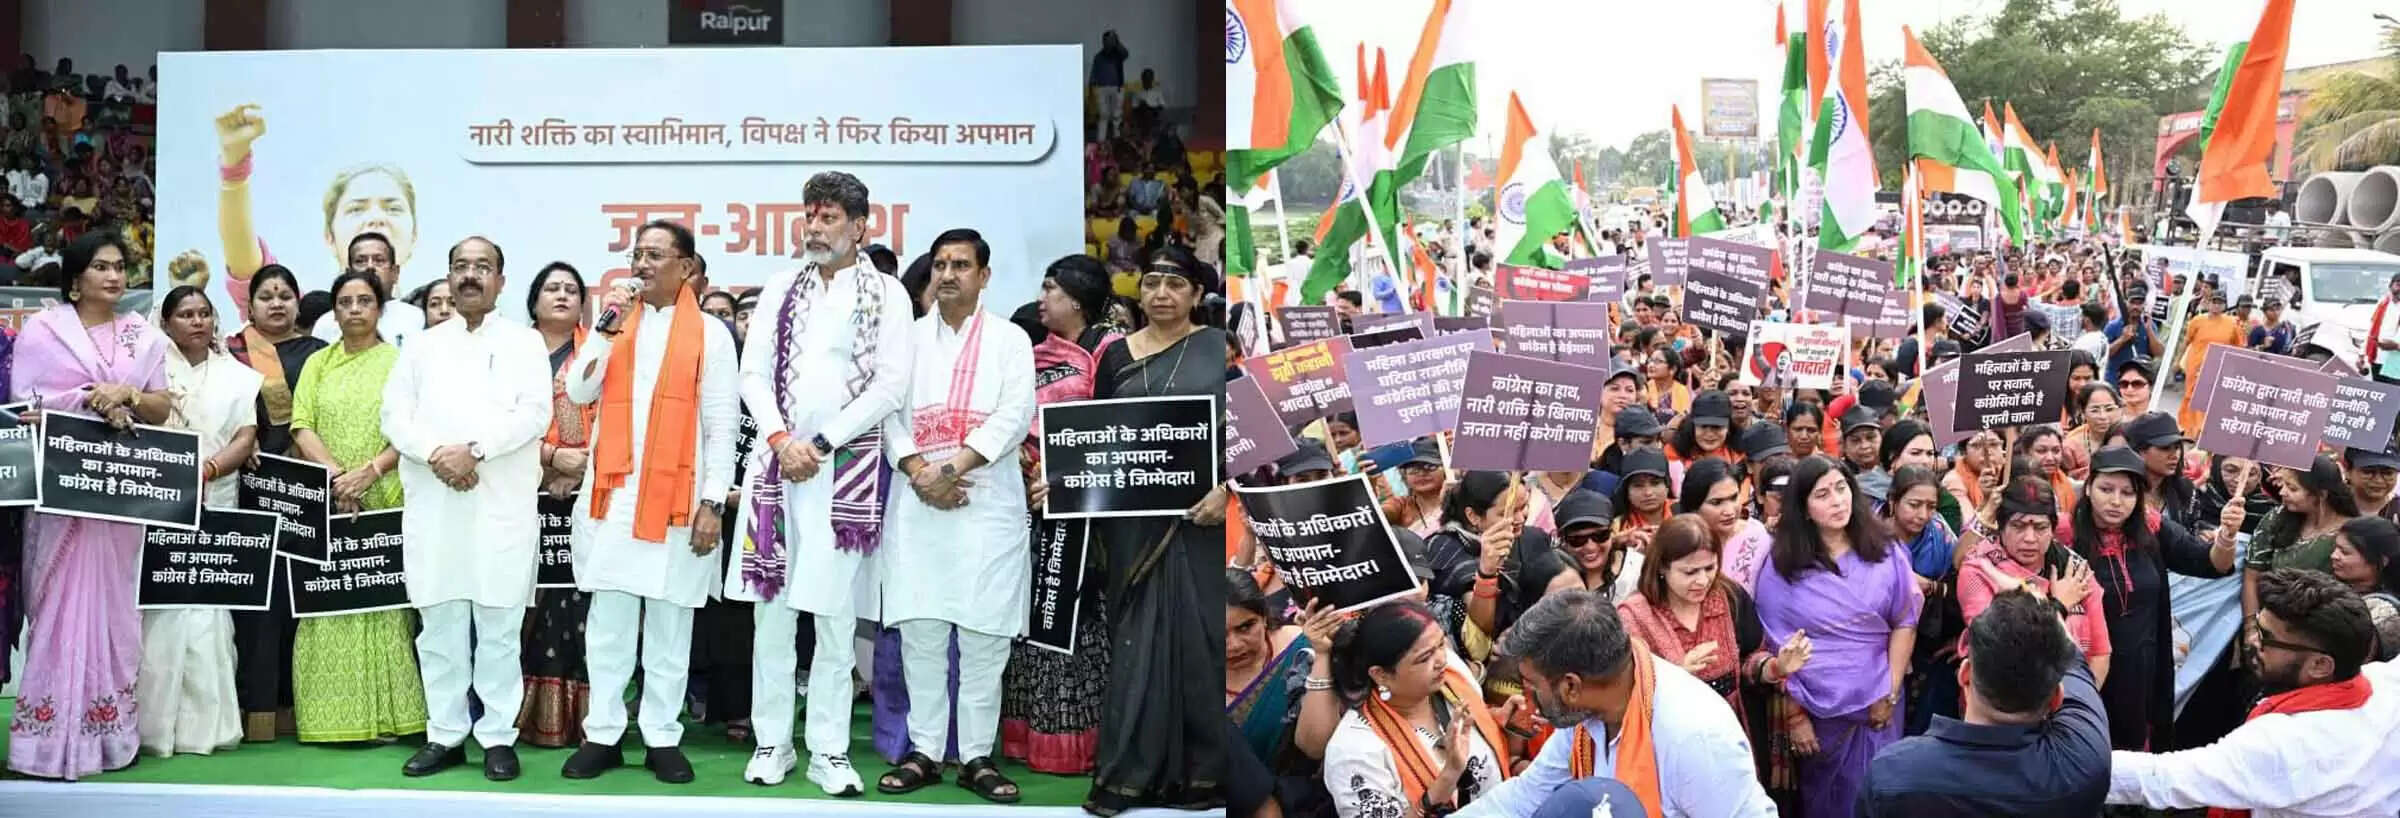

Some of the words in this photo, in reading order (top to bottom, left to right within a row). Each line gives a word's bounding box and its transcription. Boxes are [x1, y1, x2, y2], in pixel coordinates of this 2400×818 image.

[701, 11, 772, 35] Raipur
[469, 119, 513, 146] नारी
[521, 118, 577, 147] शक्ति
[583, 124, 615, 146] का
[621, 117, 733, 148] स्वाभिमान,
[741, 117, 808, 145] विपक्ष
[813, 117, 830, 145] ने
[837, 117, 882, 145] फिर
[889, 117, 948, 145] किया
[956, 123, 1035, 145] अपमान
[1509, 324, 1551, 338] महिलाओं
[1552, 328, 1567, 338] का
[1568, 329, 1603, 339] अपमान
[1518, 340, 1548, 353] कांग्रेस
[1548, 340, 1557, 354] है
[1364, 355, 1406, 371] महिला
[1408, 345, 1456, 363] आरक्षण
[1975, 359, 2020, 375] महिलाओं
[2021, 359, 2032, 373] के
[2033, 360, 2051, 373] हक
[1377, 371, 1417, 387] घटिया
[1492, 374, 1534, 395] कांग्रेस
[1535, 382, 1553, 398] का
[1554, 385, 1581, 402] हाथ,
[1988, 379, 2002, 391] पर
[2003, 378, 2034, 391] सवाल,
[1279, 394, 1314, 413] आदत
[1313, 381, 1352, 409] पुरानी
[1372, 384, 1431, 406] कांग्रेसियों
[1433, 379, 1450, 393] की
[1974, 392, 2021, 409] कांग्रेसियों
[2021, 392, 2035, 406] की
[2036, 390, 2045, 407] है
[2221, 374, 2257, 394] कांग्रेस
[2256, 382, 2280, 402] द्वारा
[2280, 385, 2303, 404] नारी
[2303, 391, 2329, 410] शक्ति
[2369, 390, 2386, 403] पर
[1398, 402, 1433, 424] पुरानी
[1466, 394, 1495, 414] नारी
[1497, 398, 1530, 418] शक्ति
[1531, 400, 1546, 418] के
[1547, 401, 1594, 425] खिलाफ,
[1981, 411, 2009, 429] पुरानी
[2011, 411, 2035, 424] चाल।
[2231, 398, 2249, 413] का
[2248, 401, 2289, 422] अपमान
[2288, 409, 2312, 427] नहीं
[1462, 421, 1501, 438] जनता
[1503, 421, 1530, 441] नहीं
[1529, 425, 1564, 442] करेगी
[1565, 429, 1592, 443] माफ
[2219, 416, 2252, 437] सहेगा
[2330, 411, 2347, 426] की
[2348, 415, 2366, 430] रही
[2366, 417, 2376, 432] है
[1048, 425, 1117, 447] महिलाओं
[1120, 424, 1137, 443] के
[1140, 422, 1209, 442] अधिकारों
[48, 434, 113, 457] महिलाओं
[115, 443, 131, 458] के
[134, 446, 196, 467] अधिकारों
[1085, 451, 1107, 466] का
[1111, 449, 1174, 466] अपमान-
[81, 458, 102, 473] का
[105, 460, 163, 480] अपमान-
[1064, 472, 1111, 489] कांग्रेस
[1114, 468, 1126, 489] है
[1128, 469, 1195, 487] जिम्मेदार।
[58, 473, 103, 492] कांग्रेस
[105, 476, 118, 496] है
[120, 481, 182, 502] जिम्मेदार।
[278, 477, 286, 495] के
[287, 481, 326, 503] अधिकारों
[259, 495, 271, 510] का
[272, 498, 304, 517] अपमान-
[549, 513, 562, 528] के
[1280, 518, 1297, 538] के
[1297, 505, 1375, 537] अधिकारों
[147, 529, 197, 546] महिलाओं
[198, 529, 211, 546] के
[213, 531, 271, 549] अधिकारों
[345, 535, 358, 552] के
[1047, 520, 1067, 574] जिम्मेदार
[170, 551, 186, 565] का
[187, 552, 238, 567] अपमान-
[338, 555, 391, 572] अपमान-
[545, 548, 555, 566] है
[1269, 546, 1283, 562] का
[1282, 543, 1342, 563] अपमान-
[152, 567, 186, 584] कांग्रेस
[188, 567, 198, 585] है
[200, 568, 254, 585] जिम्मेदार।
[304, 575, 342, 592] कांग्रेस
[343, 574, 353, 591] है
[355, 571, 408, 590] जिम्मेदार
[1044, 574, 1061, 588] है
[1293, 566, 1304, 589] है
[1303, 559, 1380, 588] जिम्मेदार।
[1042, 588, 1058, 631] कांग्रेस
